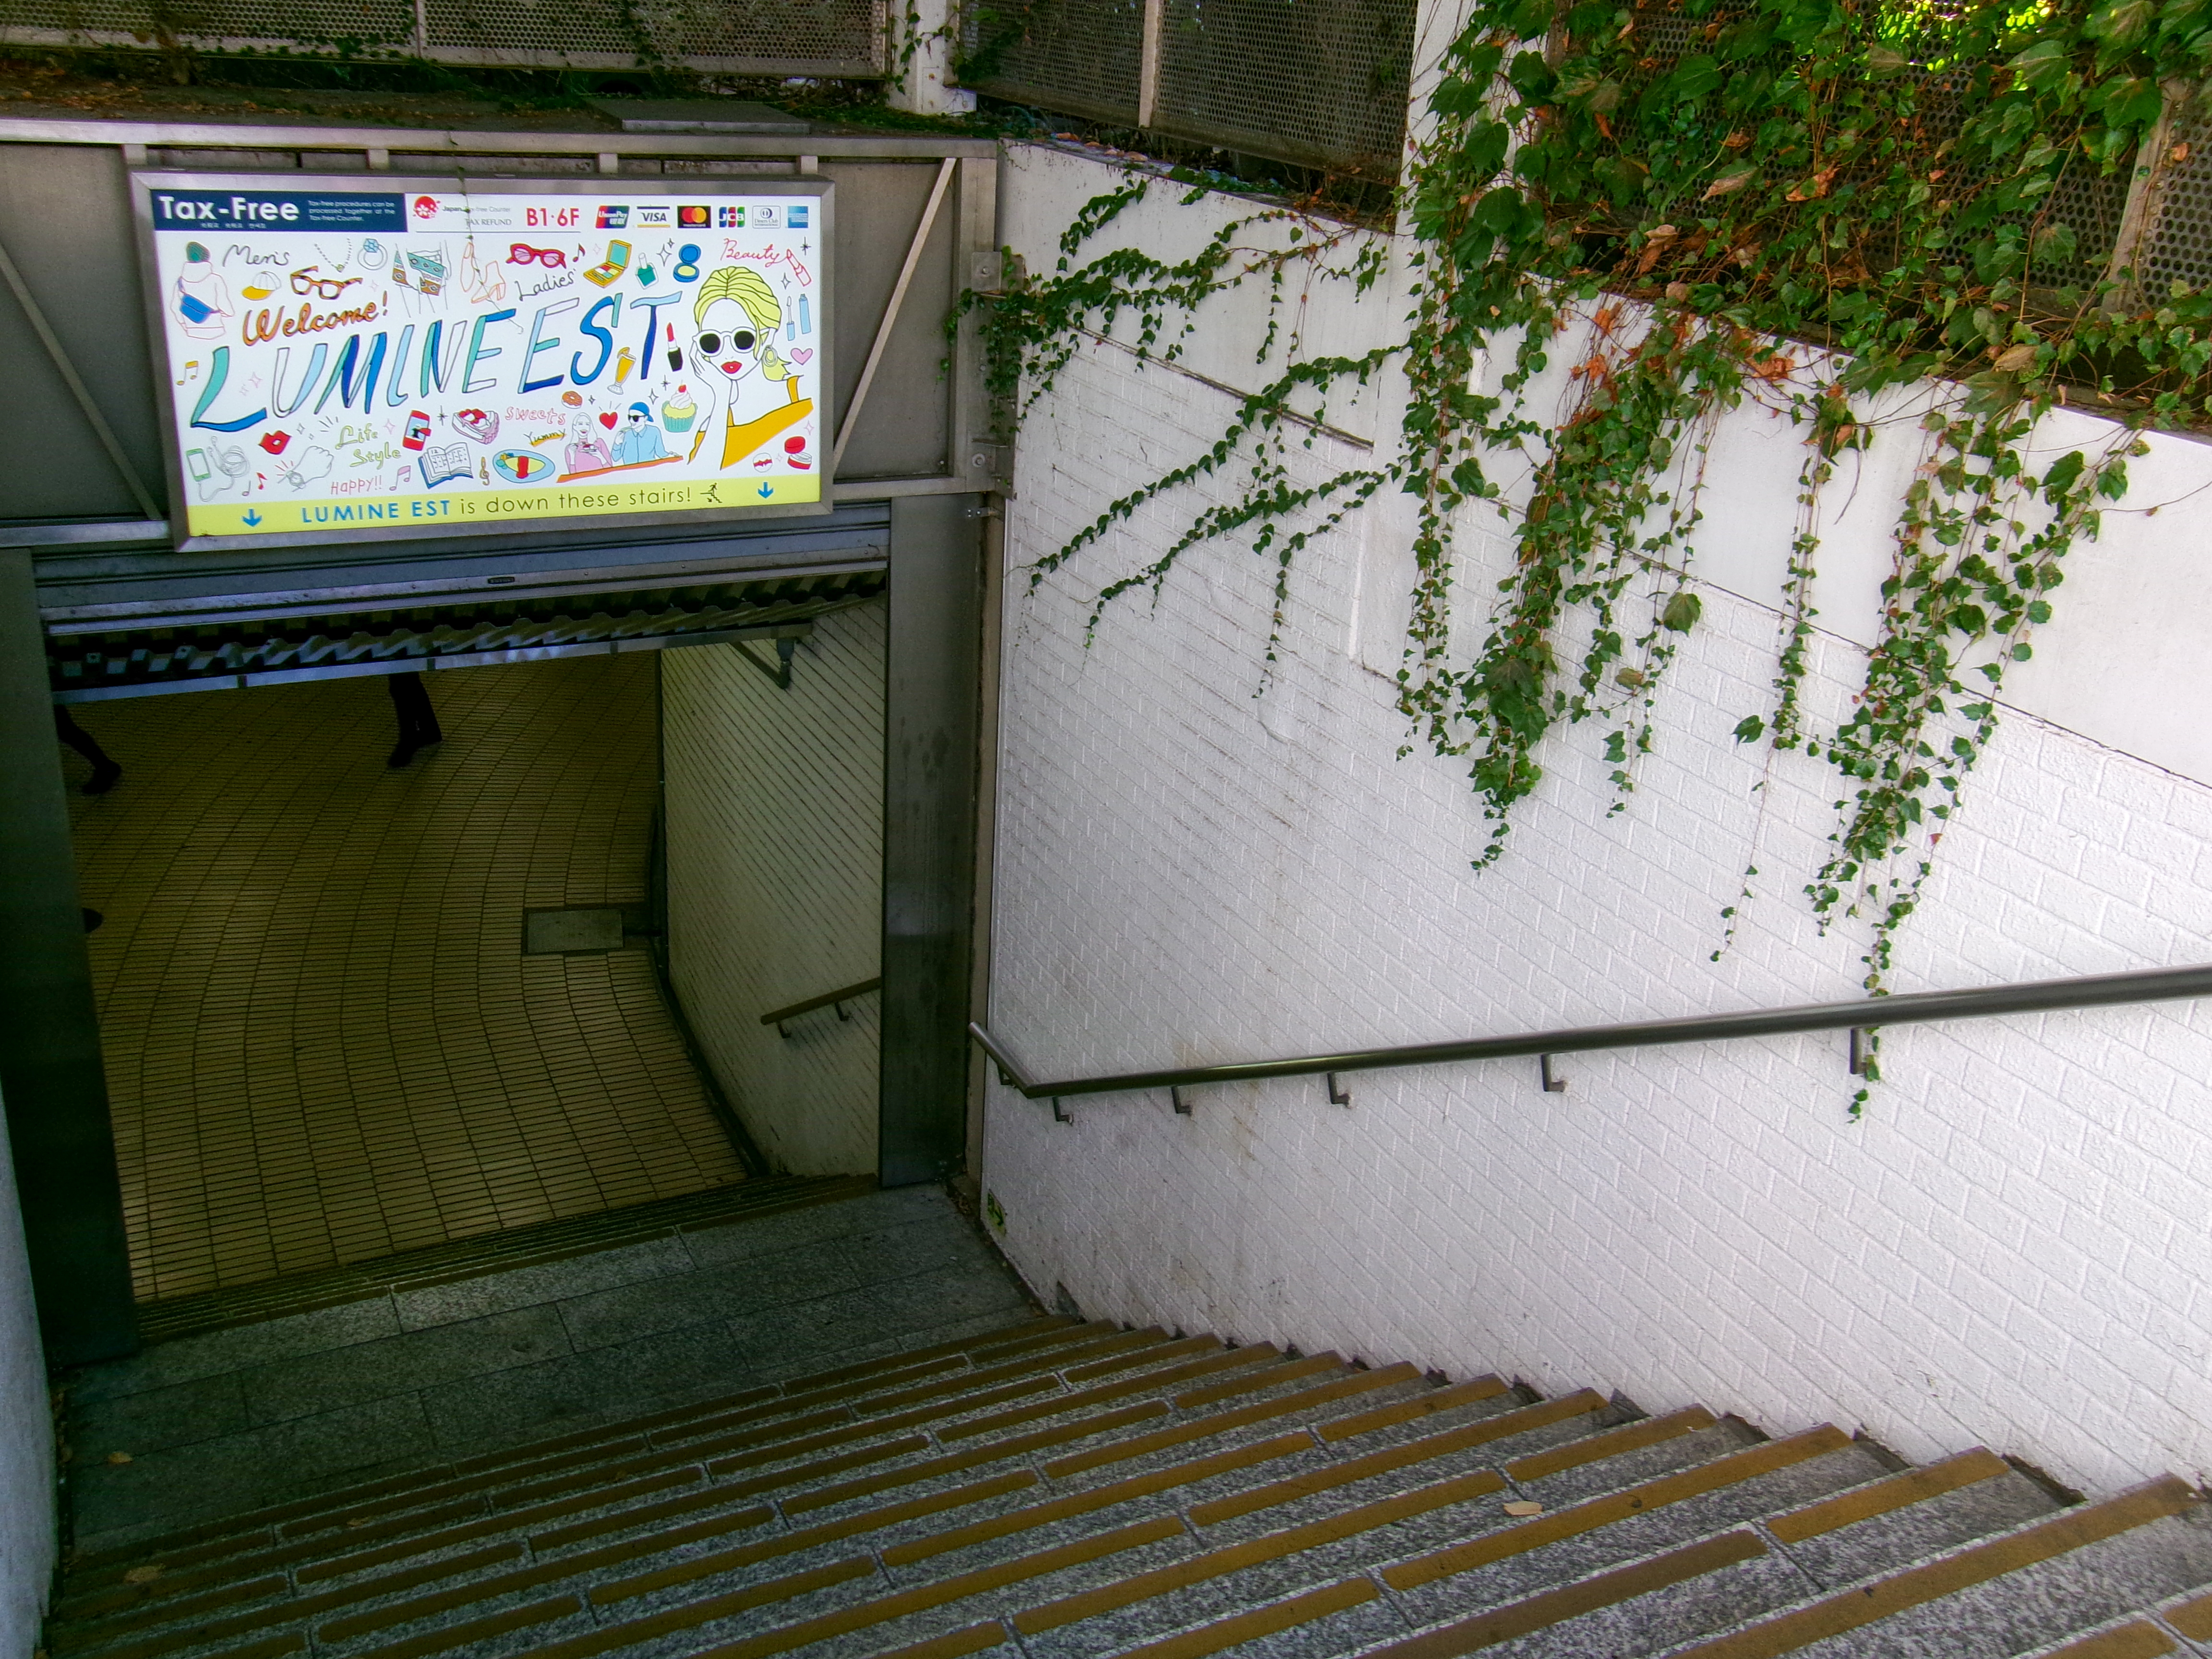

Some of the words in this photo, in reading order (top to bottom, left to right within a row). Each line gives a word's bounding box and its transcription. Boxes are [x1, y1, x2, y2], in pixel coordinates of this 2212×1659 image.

[159, 196, 299, 221] Tax-Free
[641, 212, 667, 222] VISA
[719, 213, 744, 221] JCB
[223, 244, 290, 267] Men's
[721, 238, 786, 267] Beauty
[243, 290, 387, 347] Welcome!
[191, 308, 516, 432] LUMINE
[517, 290, 683, 394] EST
[335, 423, 378, 450] Life
[349, 441, 401, 469] Style
[301, 503, 399, 523] LUMINE
[411, 500, 450, 517] EST
[460, 498, 475, 515] is
[486, 497, 548, 513] down
[559, 493, 619, 509] these
[629, 486, 691, 506] stairs!
